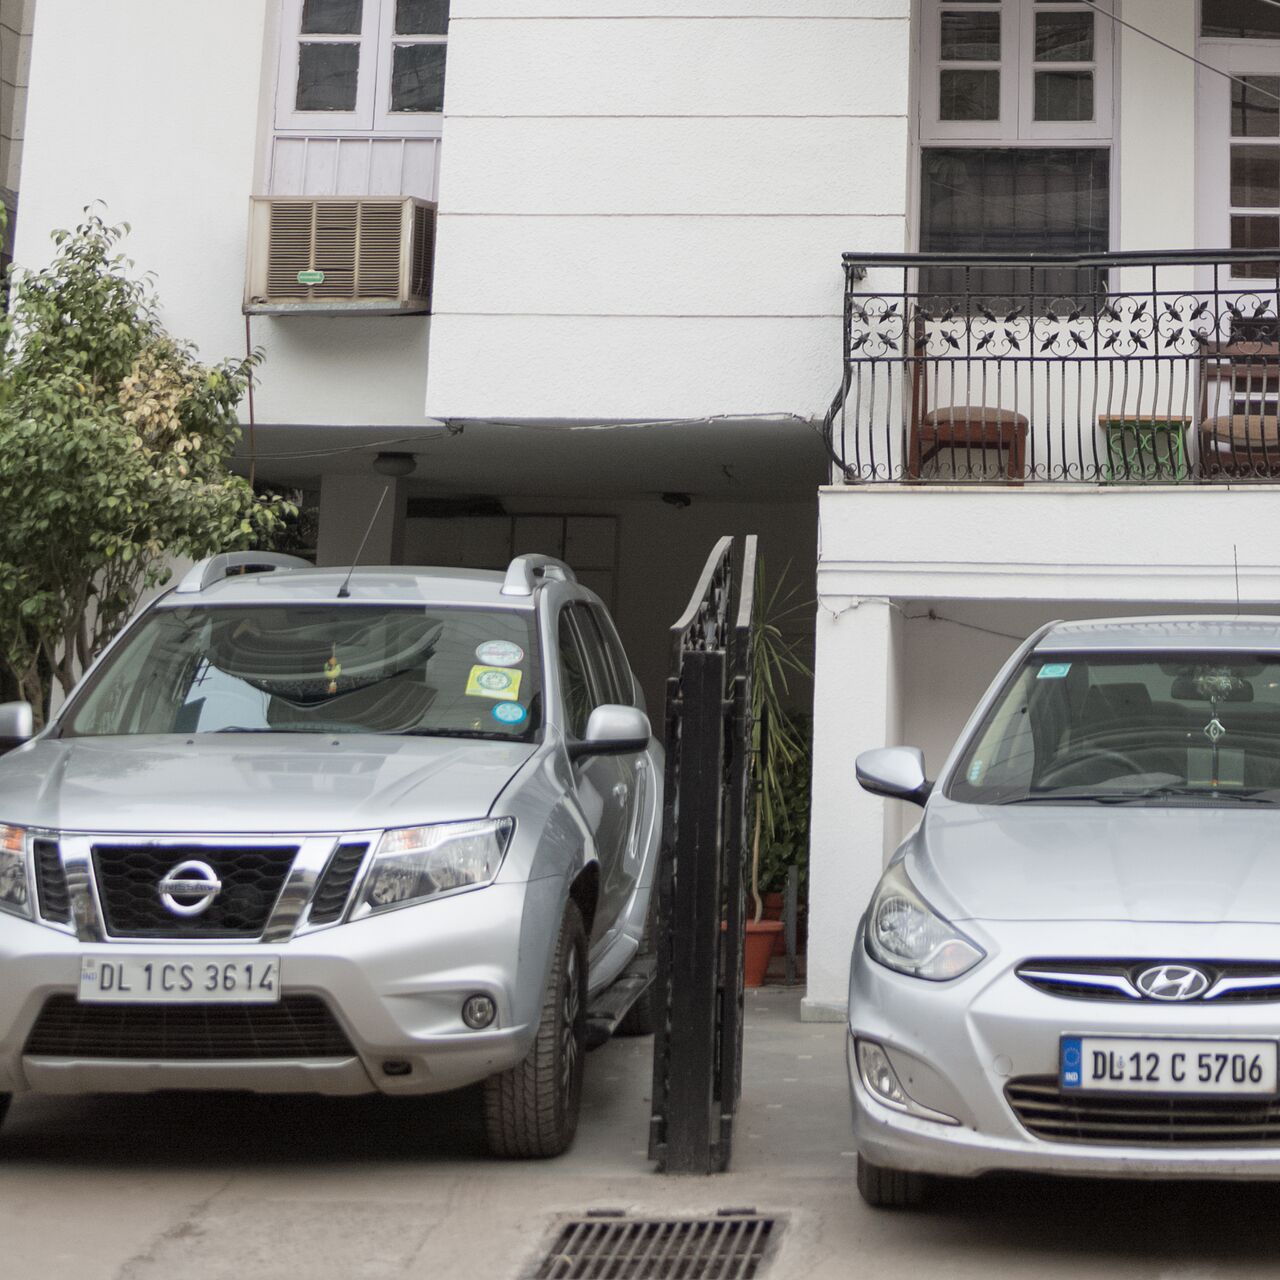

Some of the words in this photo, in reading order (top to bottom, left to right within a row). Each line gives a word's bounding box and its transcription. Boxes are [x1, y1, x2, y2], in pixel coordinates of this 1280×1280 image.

[100, 963, 132, 991] DL
[204, 963, 273, 991] 3614
[1065, 1072, 1079, 1081] IND
[1171, 1053, 1186, 1082] C
[1198, 1053, 1263, 1083] 5706
